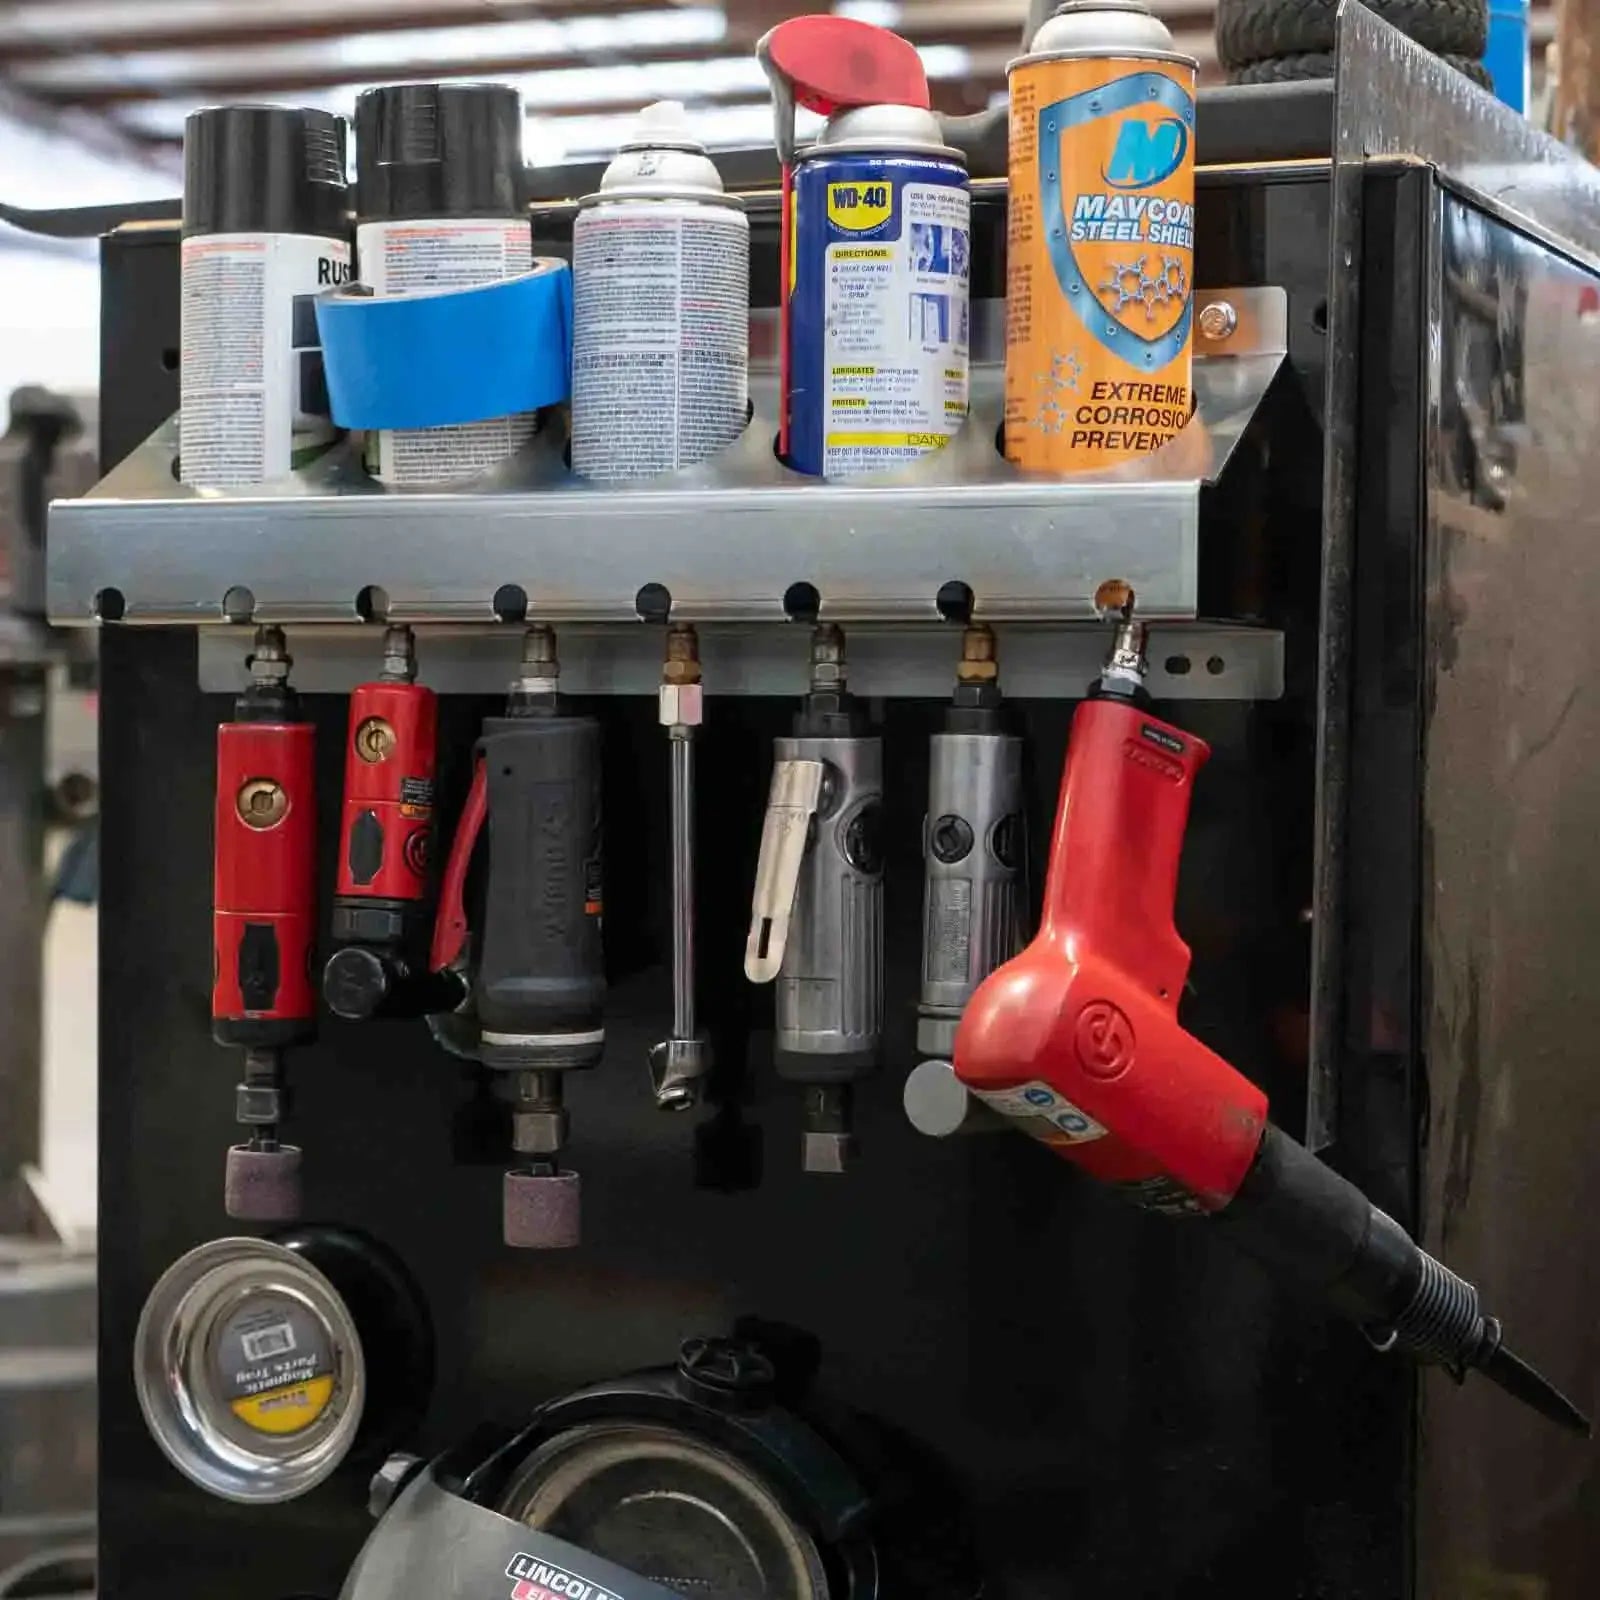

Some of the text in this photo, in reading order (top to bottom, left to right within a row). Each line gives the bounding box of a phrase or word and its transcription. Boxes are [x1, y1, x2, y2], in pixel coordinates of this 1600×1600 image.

[832, 186, 888, 209] WD-40
[1071, 220, 1144, 241] STEEL
[834, 249, 888, 259] DIRECTIONS
[832, 367, 875, 375] LUBRICATES
[1091, 382, 1187, 406] EXTREME
[832, 399, 866, 407] PROTECTS
